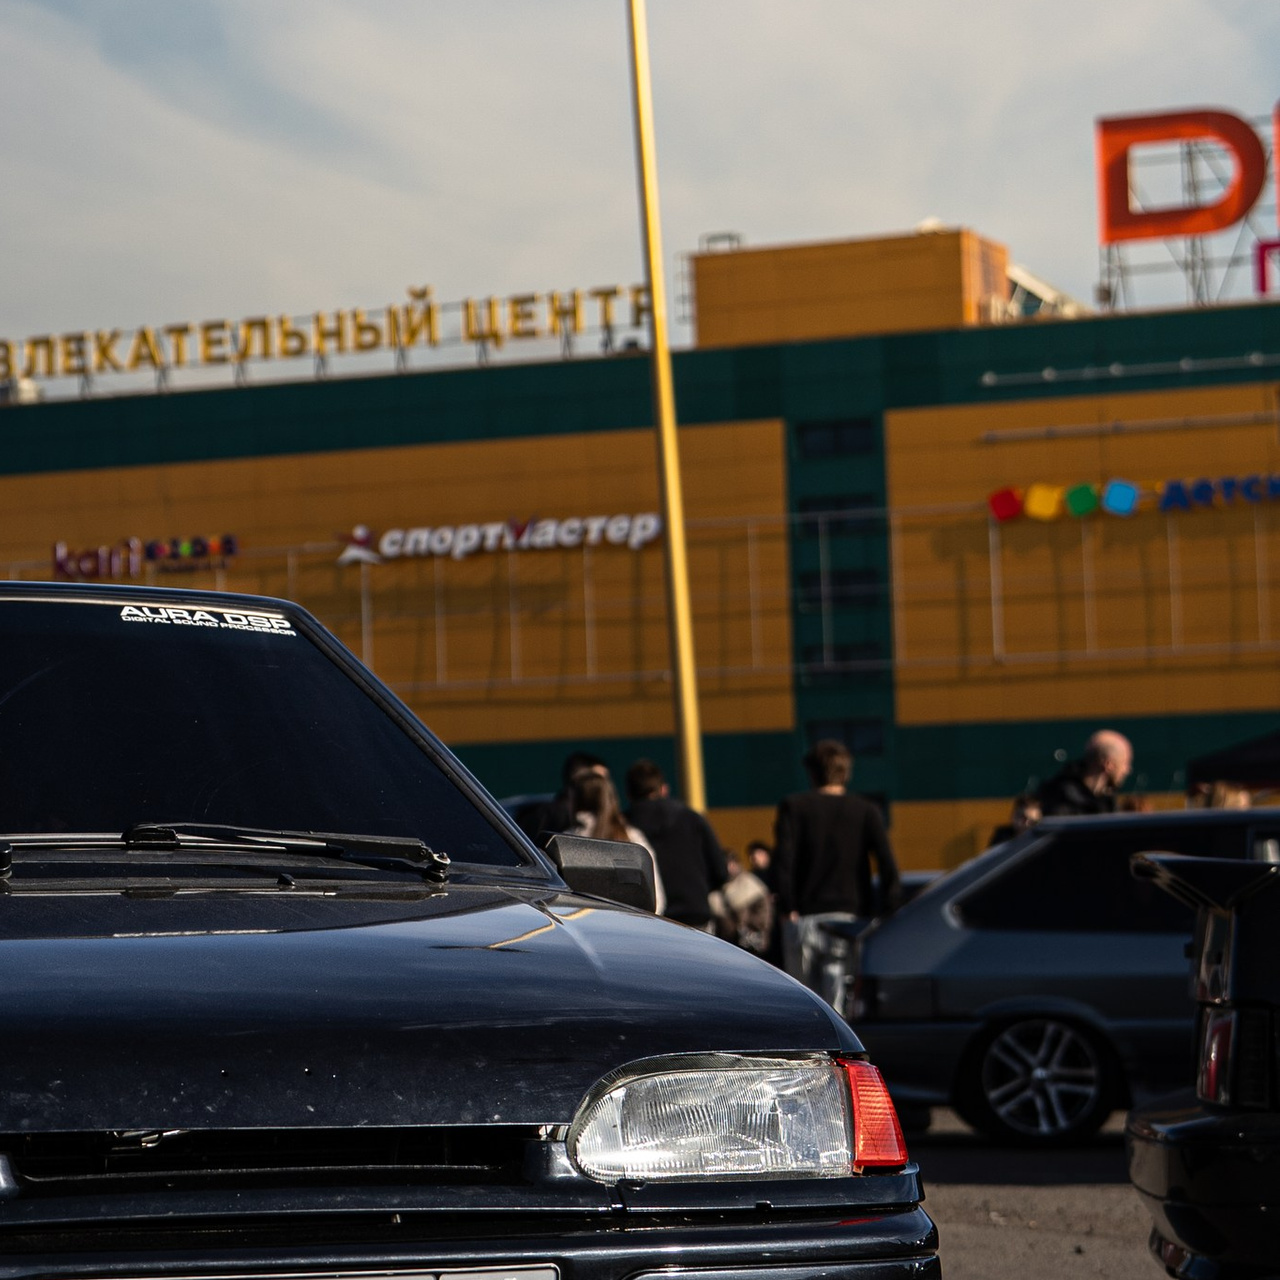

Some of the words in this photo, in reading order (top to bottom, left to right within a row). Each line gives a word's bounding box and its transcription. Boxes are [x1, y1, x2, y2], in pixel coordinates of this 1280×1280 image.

[120, 606, 219, 623] AURA
[223, 613, 291, 630] DSP
[122, 616, 171, 624] DIGITAL
[173, 619, 219, 628] SOUND
[221, 623, 297, 637] PROCESSOR
